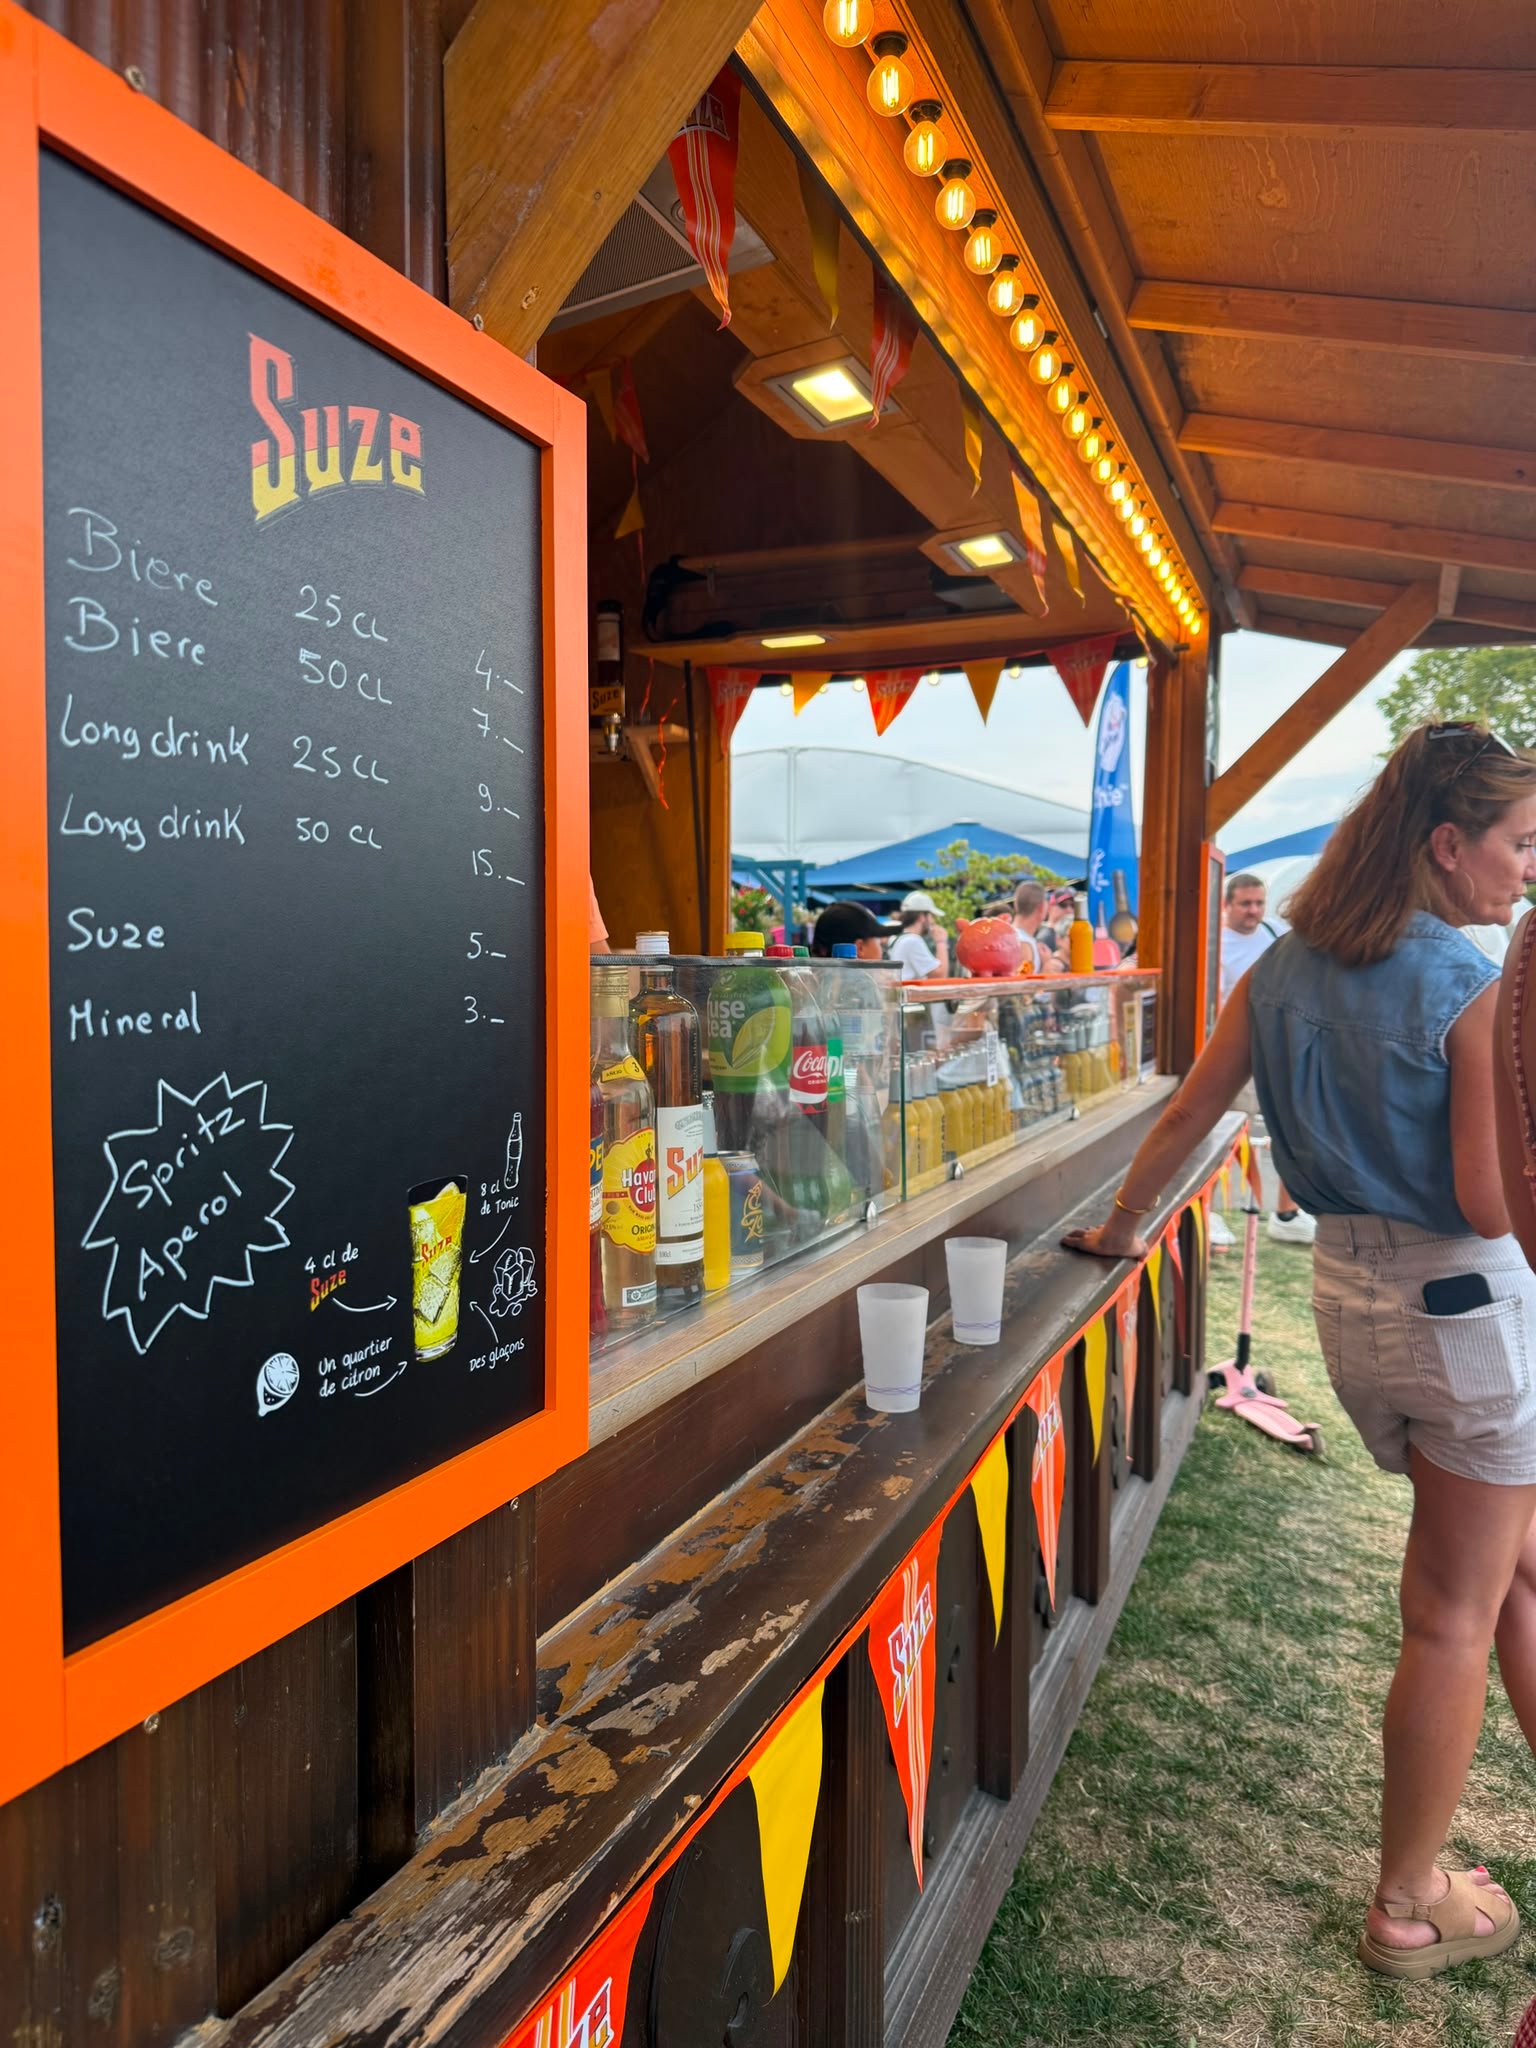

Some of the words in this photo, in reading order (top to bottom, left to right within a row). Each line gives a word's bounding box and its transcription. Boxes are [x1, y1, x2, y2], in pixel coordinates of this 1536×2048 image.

[249, 333, 427, 524] Suze
[67, 508, 218, 606] Biere
[296, 585, 341, 628] 25
[64, 596, 206, 666] Biere
[299, 648, 348, 690] 50
[292, 735, 342, 779] 25
[60, 793, 146, 851] Long
[158, 804, 246, 845] drink
[296, 817, 330, 844] 50
[67, 907, 166, 952] Suze
[69, 990, 202, 1041] Mineral
[707, 1000, 746, 1019] use
[122, 1106, 247, 1210] Spritz
[480, 1182, 488, 1197] 8
[490, 1179, 500, 1194] cl
[480, 1201, 492, 1216] de
[138, 1170, 243, 1301] Aperol
[304, 1256, 317, 1274] 4
[323, 1250, 336, 1269] cl
[341, 1242, 359, 1264] de
[310, 1269, 347, 1313] Suze
[318, 1356, 337, 1377] Un
[342, 1336, 393, 1370] quartier
[469, 1355, 486, 1372] Des
[489, 1337, 525, 1370] glaçons
[319, 1378, 336, 1398] de
[341, 1364, 381, 1391] citron
